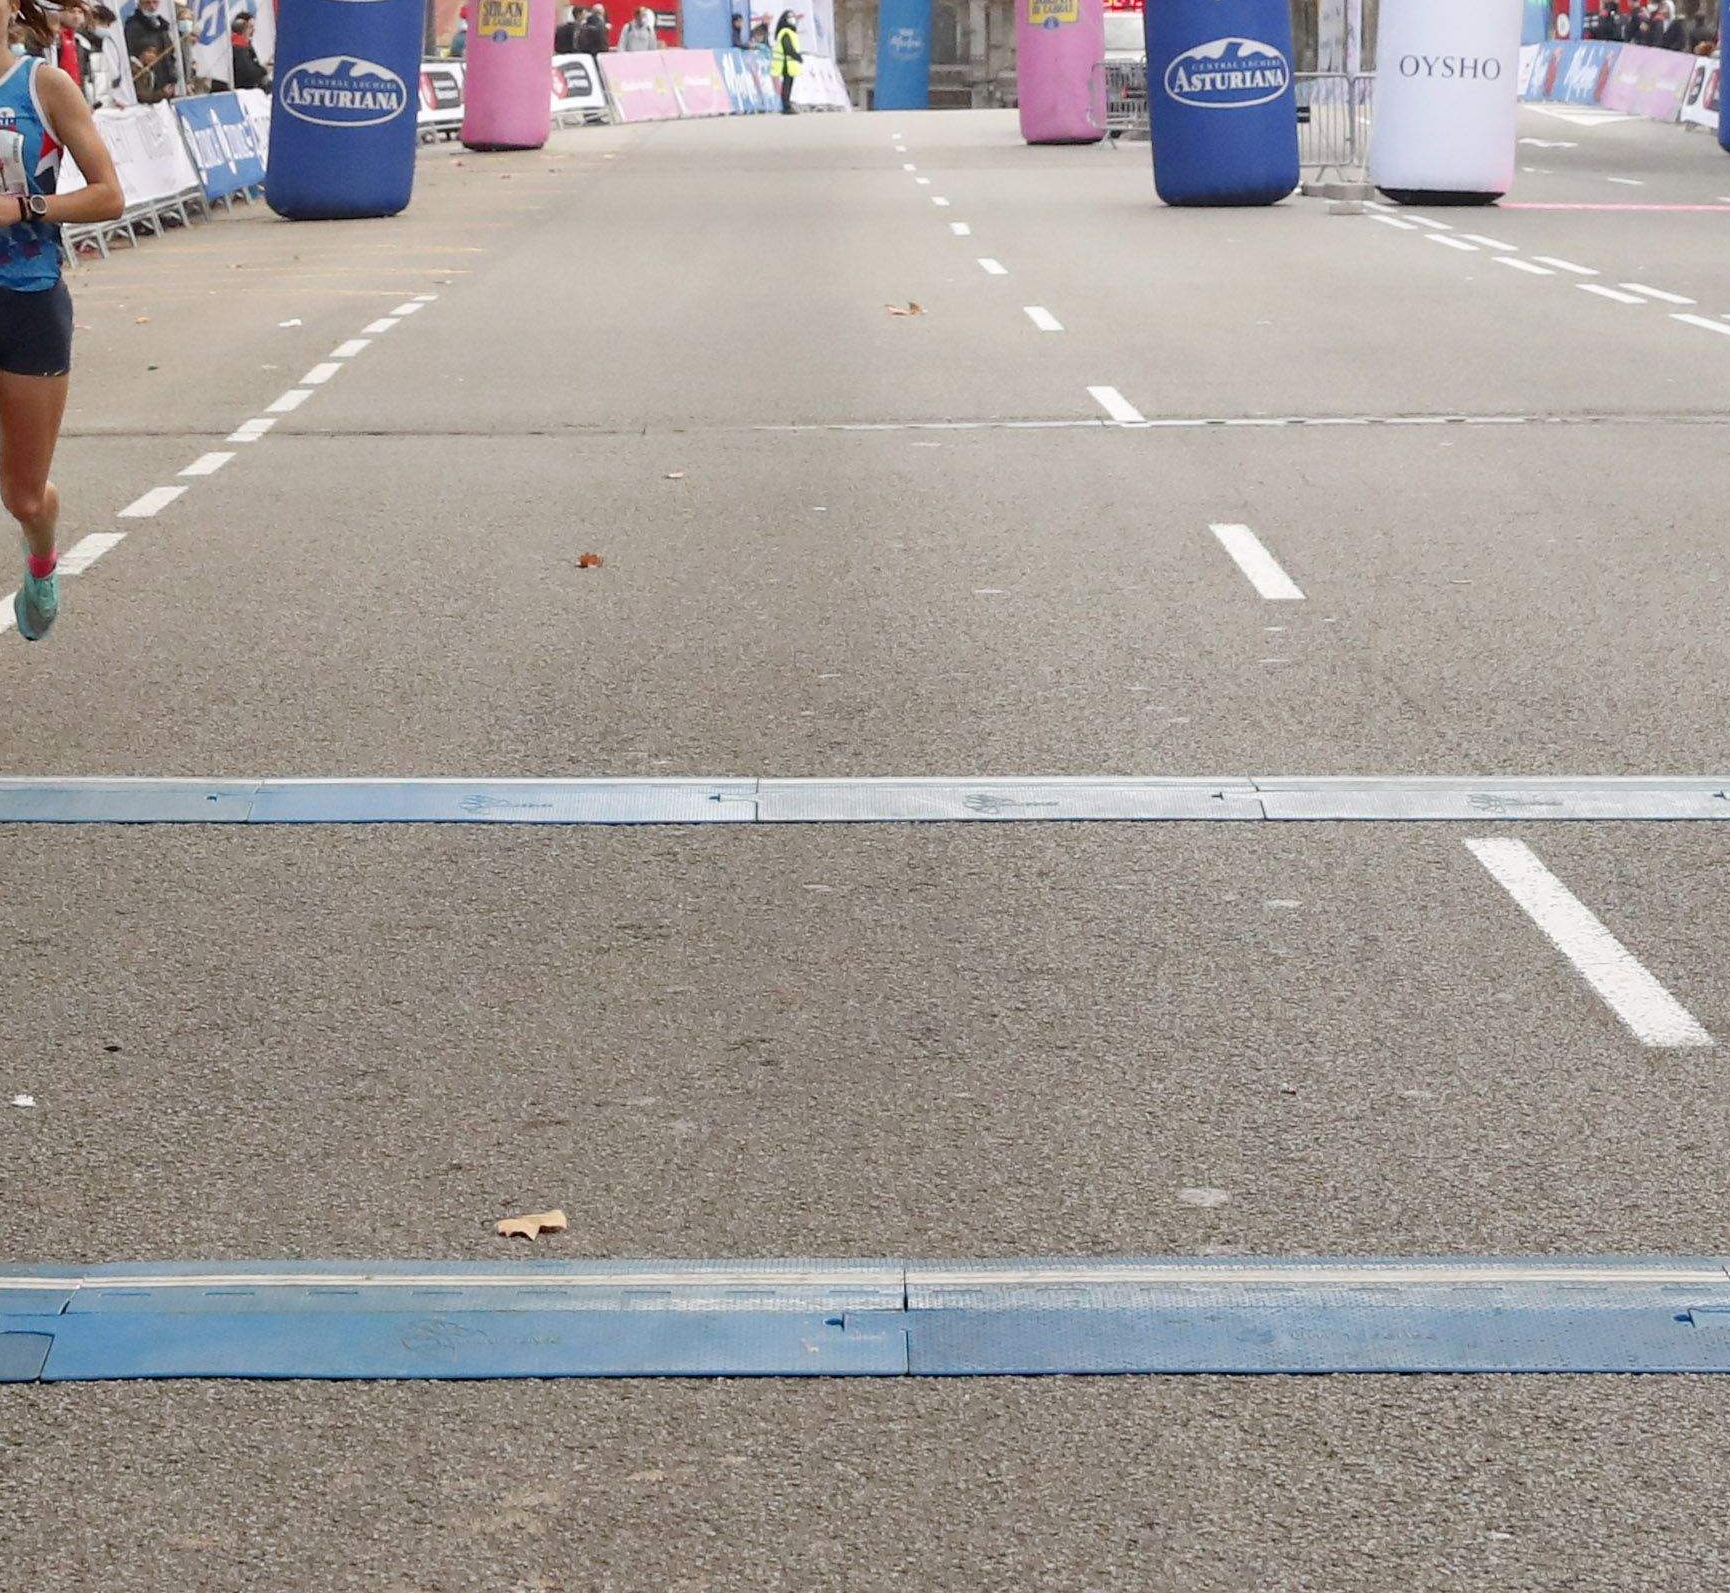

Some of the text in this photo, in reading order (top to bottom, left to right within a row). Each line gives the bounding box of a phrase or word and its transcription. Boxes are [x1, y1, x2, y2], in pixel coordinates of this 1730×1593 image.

[1175, 66, 1284, 93] ASTURIANA
[1399, 55, 1502, 82] OYSHO
[285, 80, 399, 111] ASTURIANA
